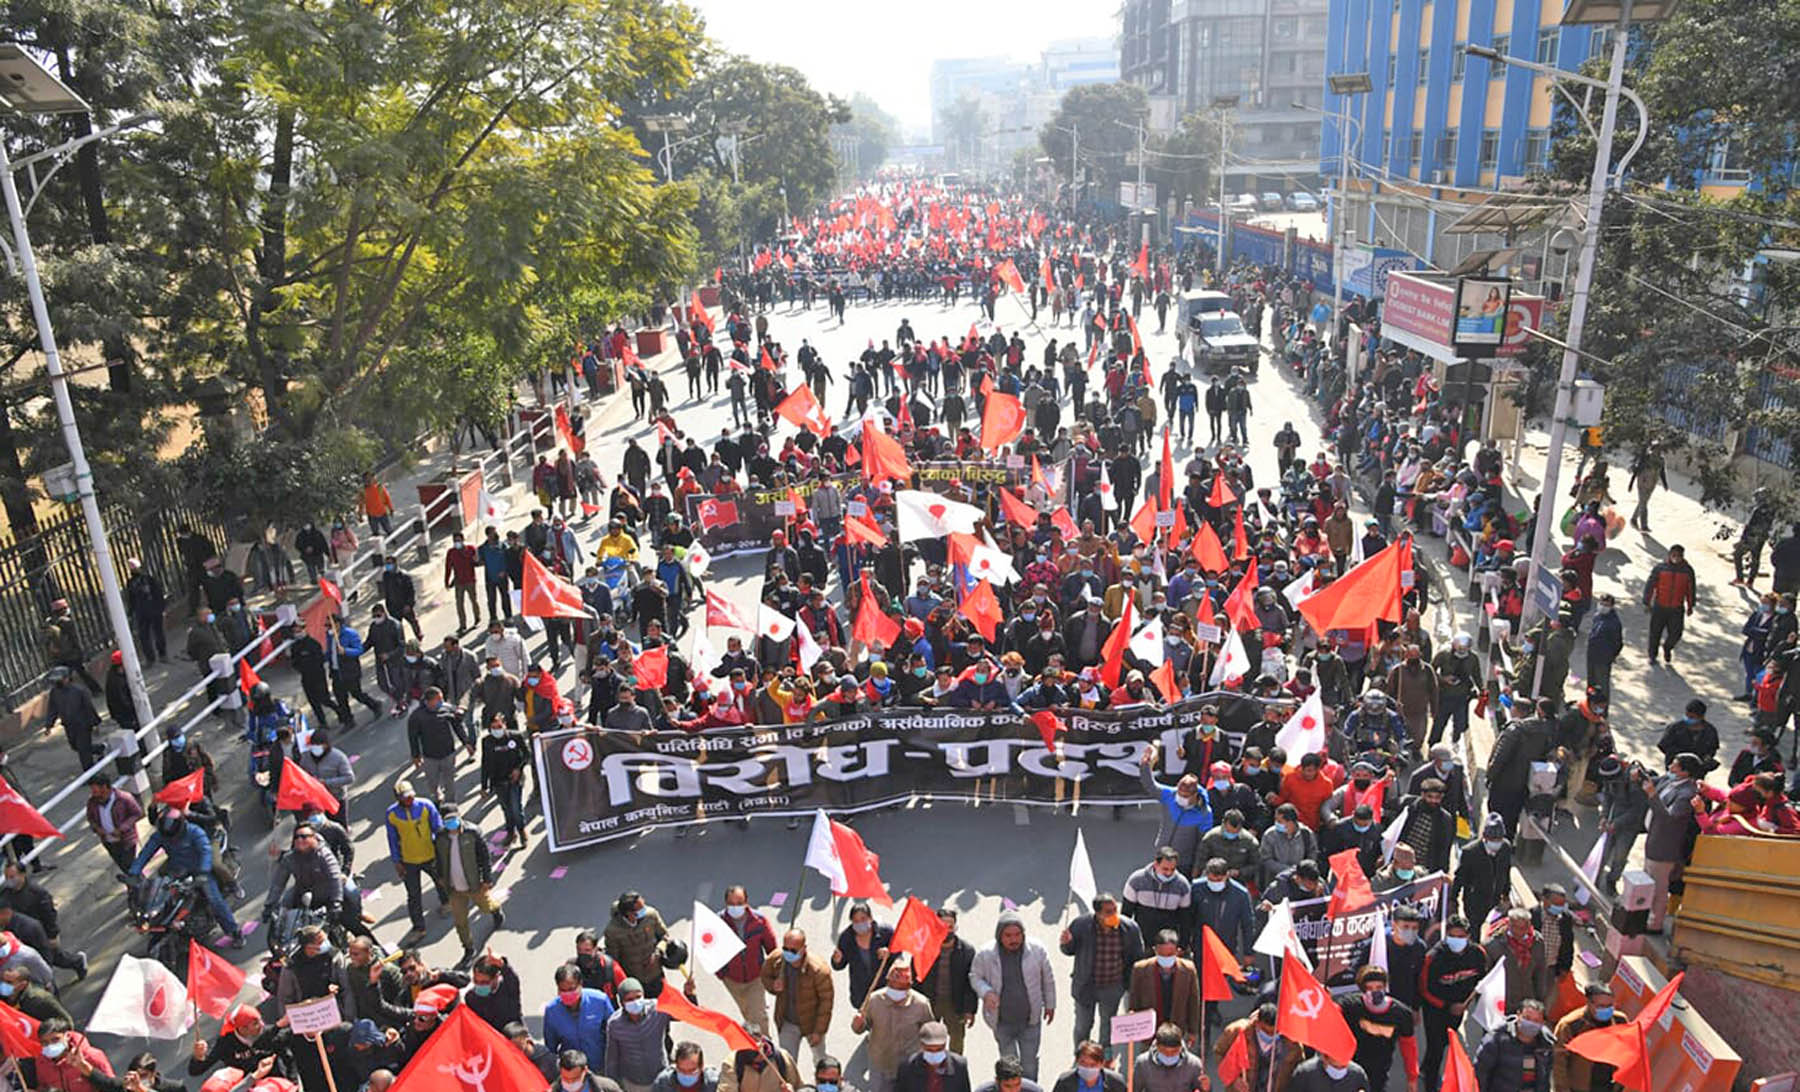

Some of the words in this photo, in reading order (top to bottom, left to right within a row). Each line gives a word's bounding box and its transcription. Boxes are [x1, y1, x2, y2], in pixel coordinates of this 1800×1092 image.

[878, 714, 985, 731] असंवैधानिक
[1072, 715, 1121, 734] विरुद्ध
[578, 815, 620, 834] नेपाल
